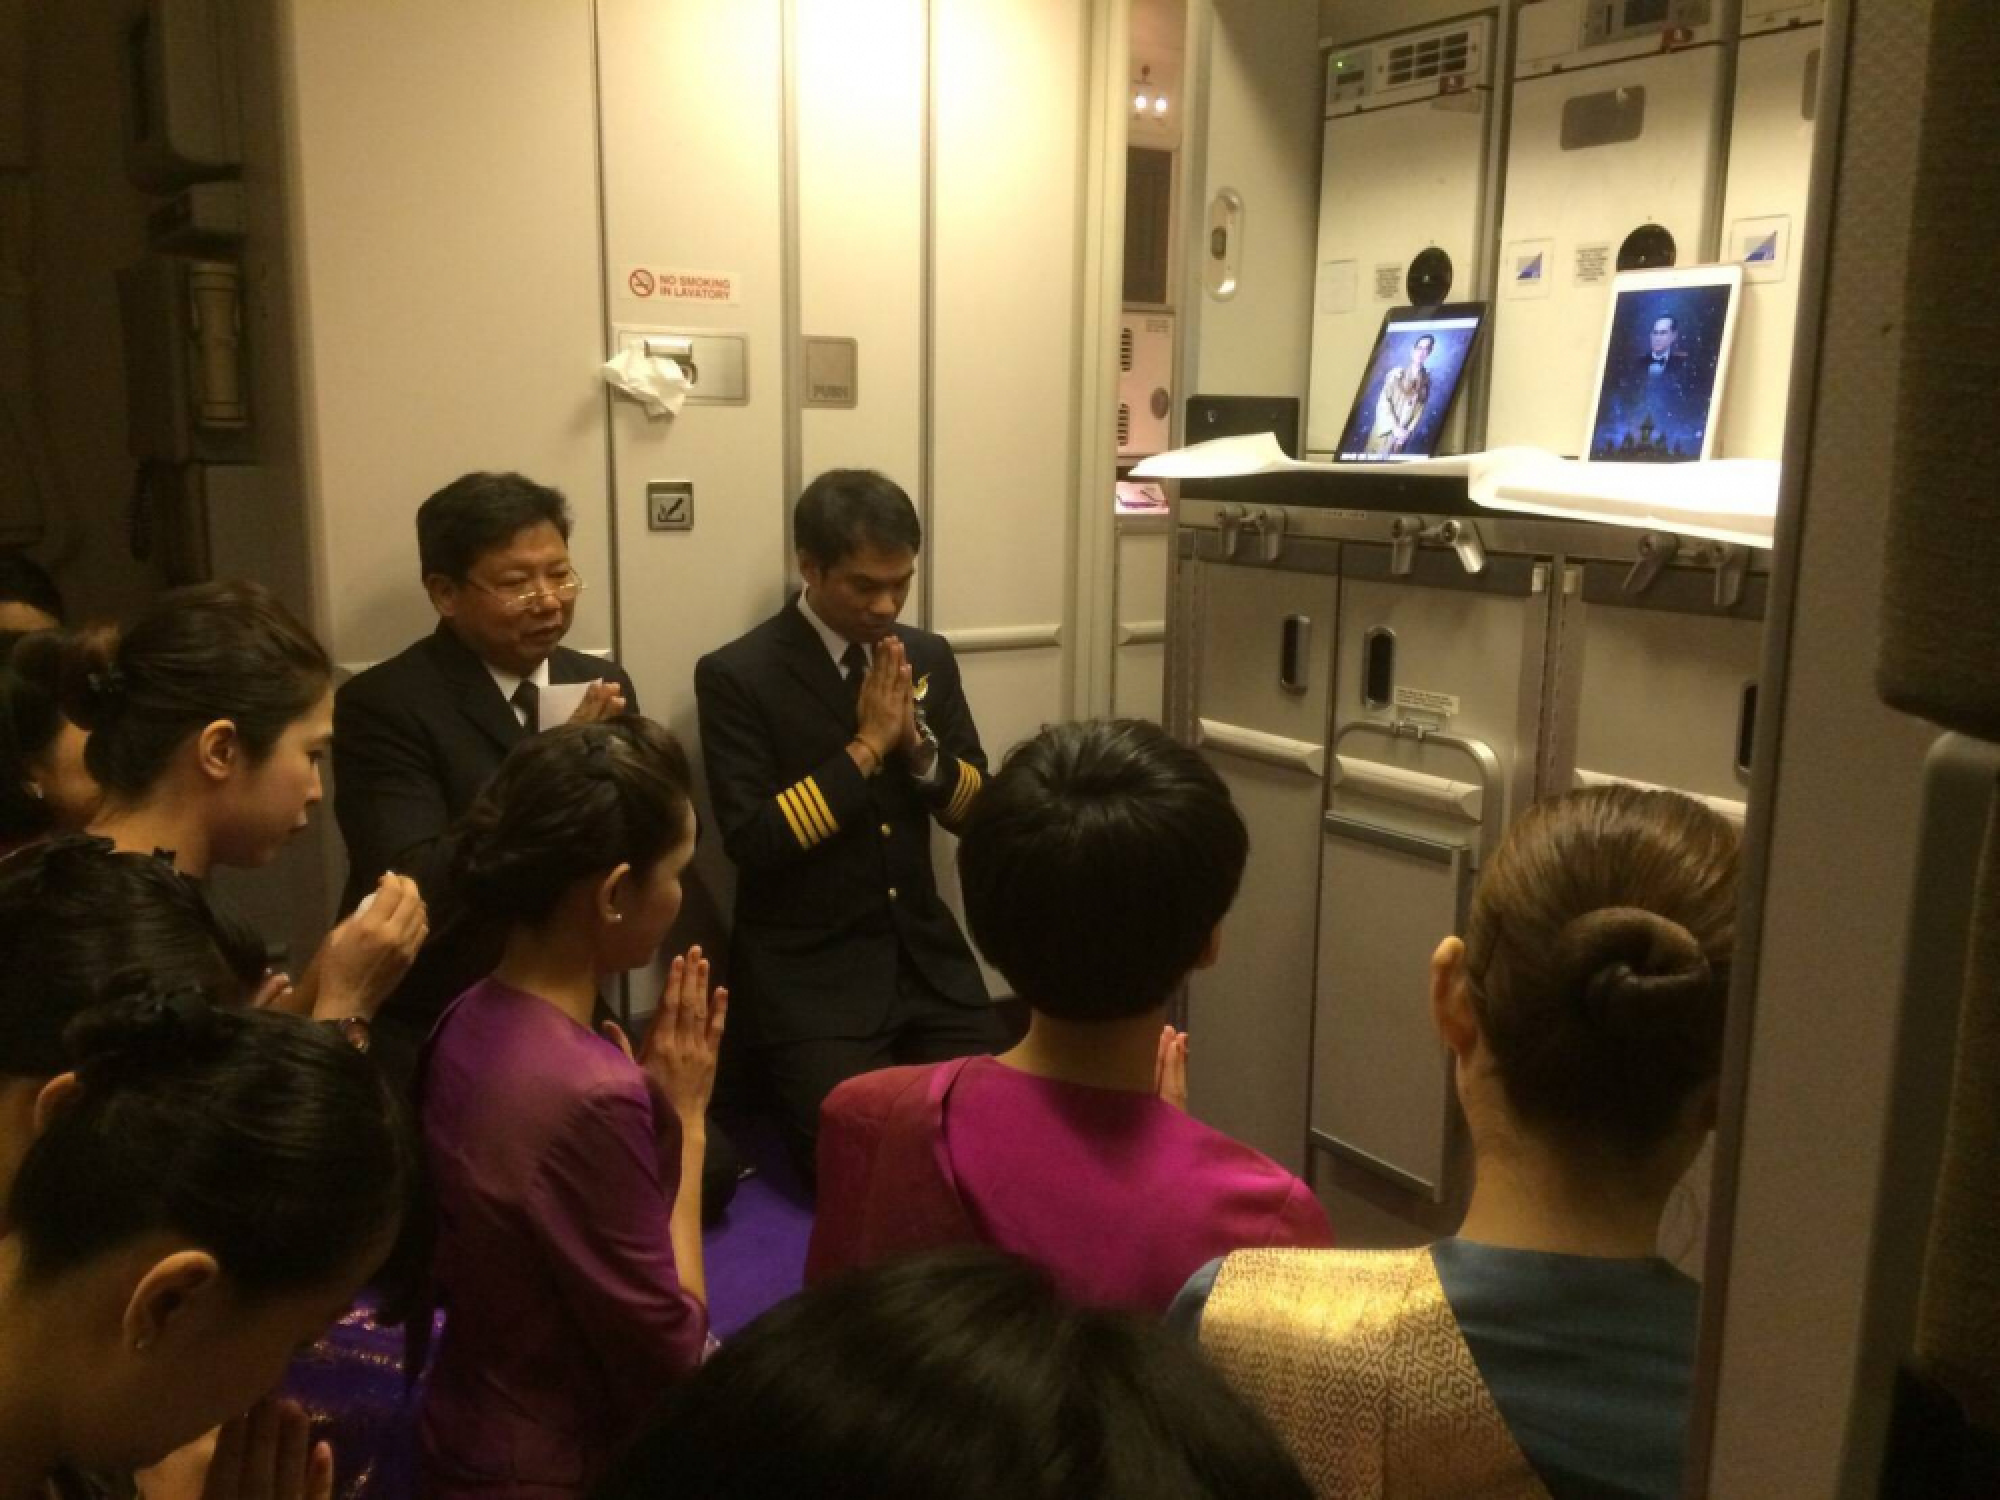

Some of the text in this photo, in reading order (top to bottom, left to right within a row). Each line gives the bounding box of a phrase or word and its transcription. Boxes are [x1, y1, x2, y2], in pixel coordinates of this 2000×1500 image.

[659, 275, 731, 288] NO SMOKING
[659, 286, 731, 300] IN LAVATORY
